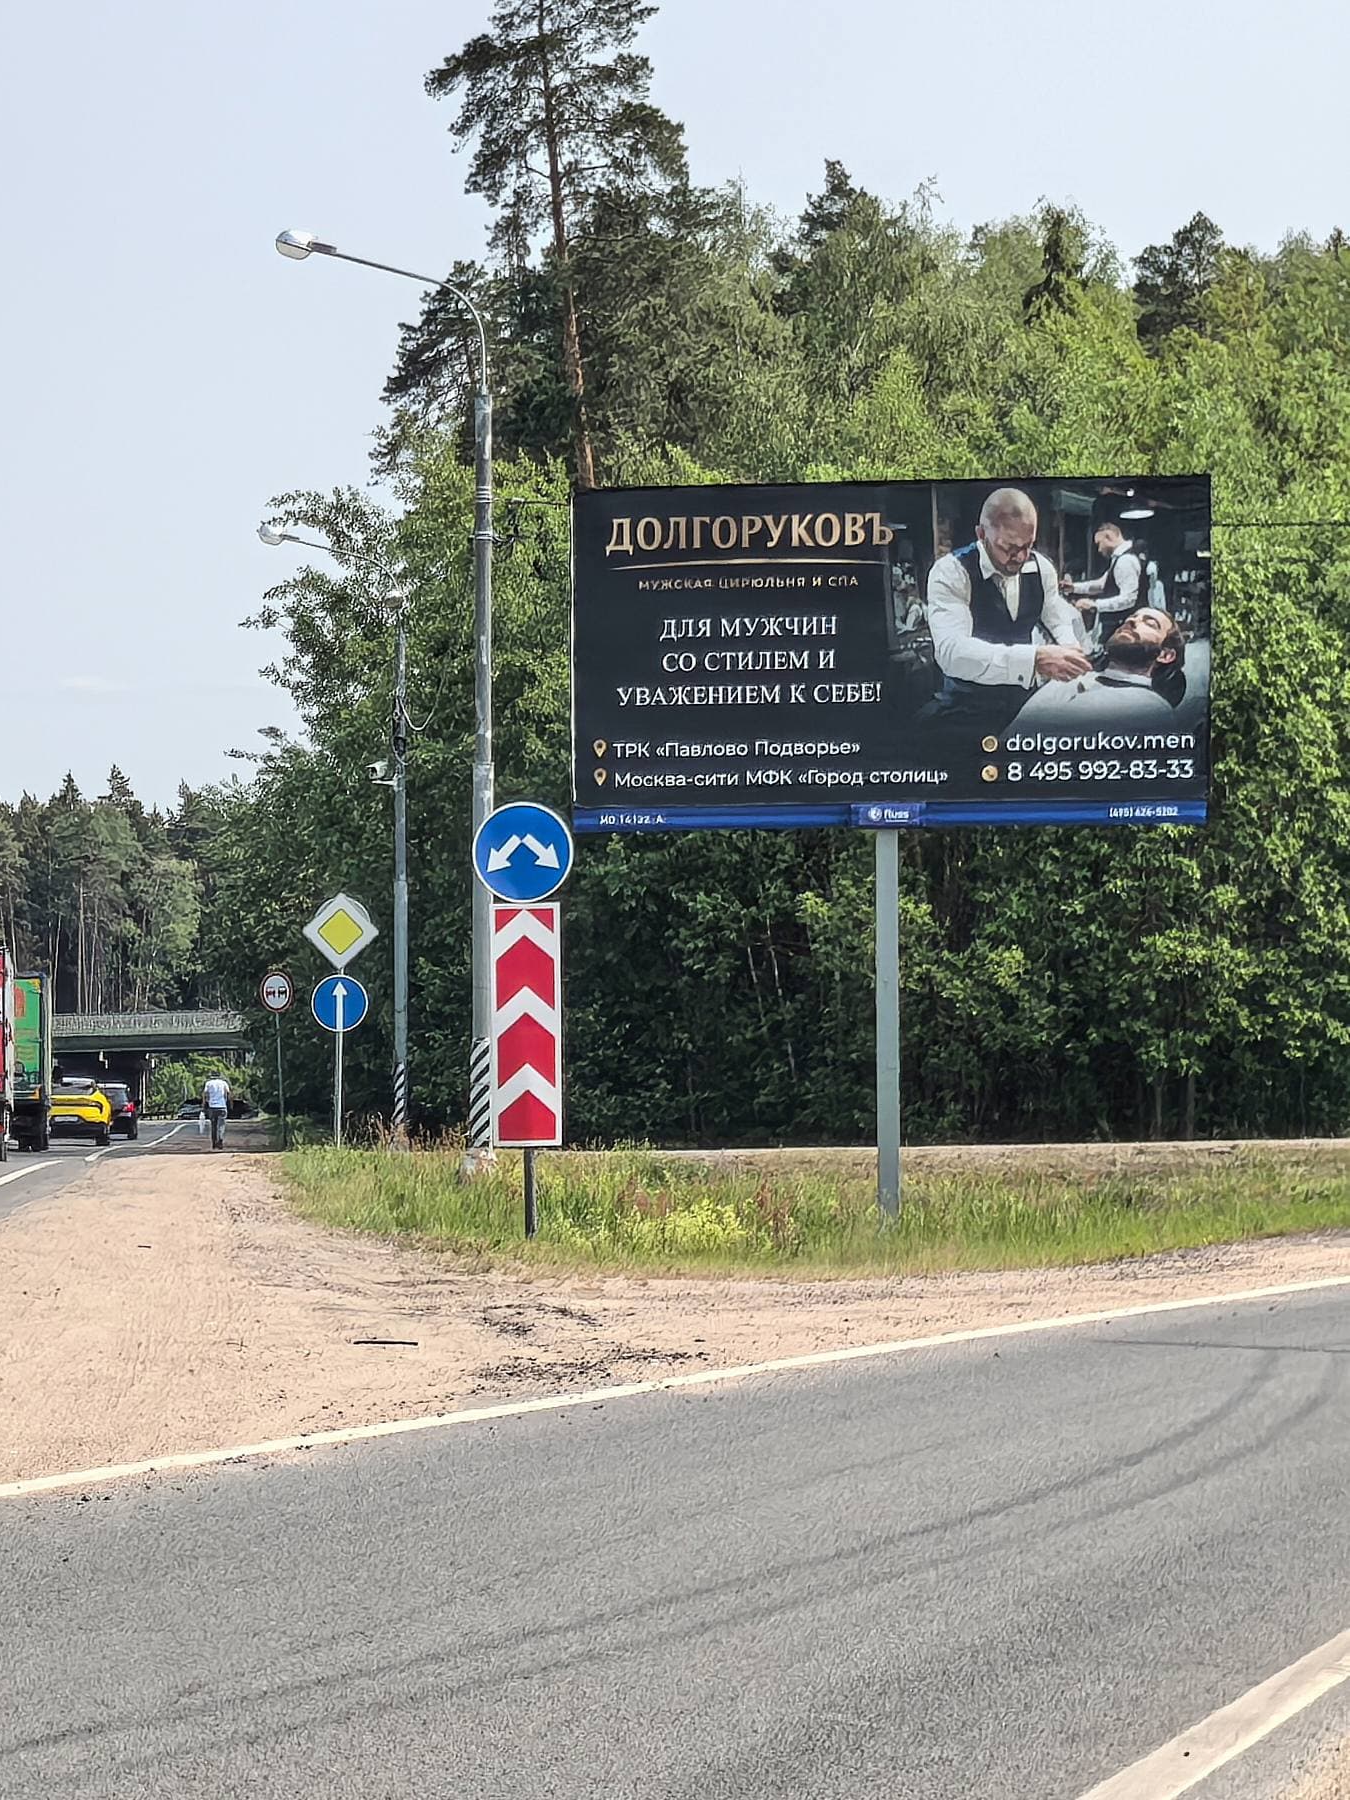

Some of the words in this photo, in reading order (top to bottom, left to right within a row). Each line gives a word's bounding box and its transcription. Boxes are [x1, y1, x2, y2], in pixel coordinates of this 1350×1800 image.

[605, 512, 895, 557] ДОЛГОРУКОВЪ
[638, 577, 713, 591] МУЖСКАЯ
[718, 576, 805, 590] ЦИРЮЛЬНЯ
[812, 575, 822, 588] И
[828, 575, 859, 588] СПА
[659, 617, 711, 642] ДЛЯ
[720, 615, 837, 638] МУЖЧИН
[662, 652, 696, 672] СО
[704, 650, 809, 671] СТИЛЕМ
[818, 649, 835, 669] И
[617, 684, 781, 706] УВАЖЕНИЕМ
[789, 684, 806, 704] К
[813, 681, 882, 703] СЕБЕ!
[612, 741, 650, 758] ТРК
[656, 739, 749, 757] «Павлово
[754, 740, 861, 758] Подворье»
[1006, 731, 1195, 756] dolgorukov.men
[614, 772, 739, 788] Москва-сити
[746, 769, 792, 786] МФК
[798, 769, 863, 787] «Город
[869, 769, 949, 786] столиц»
[1007, 761, 1022, 782] 8
[1029, 761, 1072, 781] 495
[1078, 759, 1194, 780] 992-83-33
